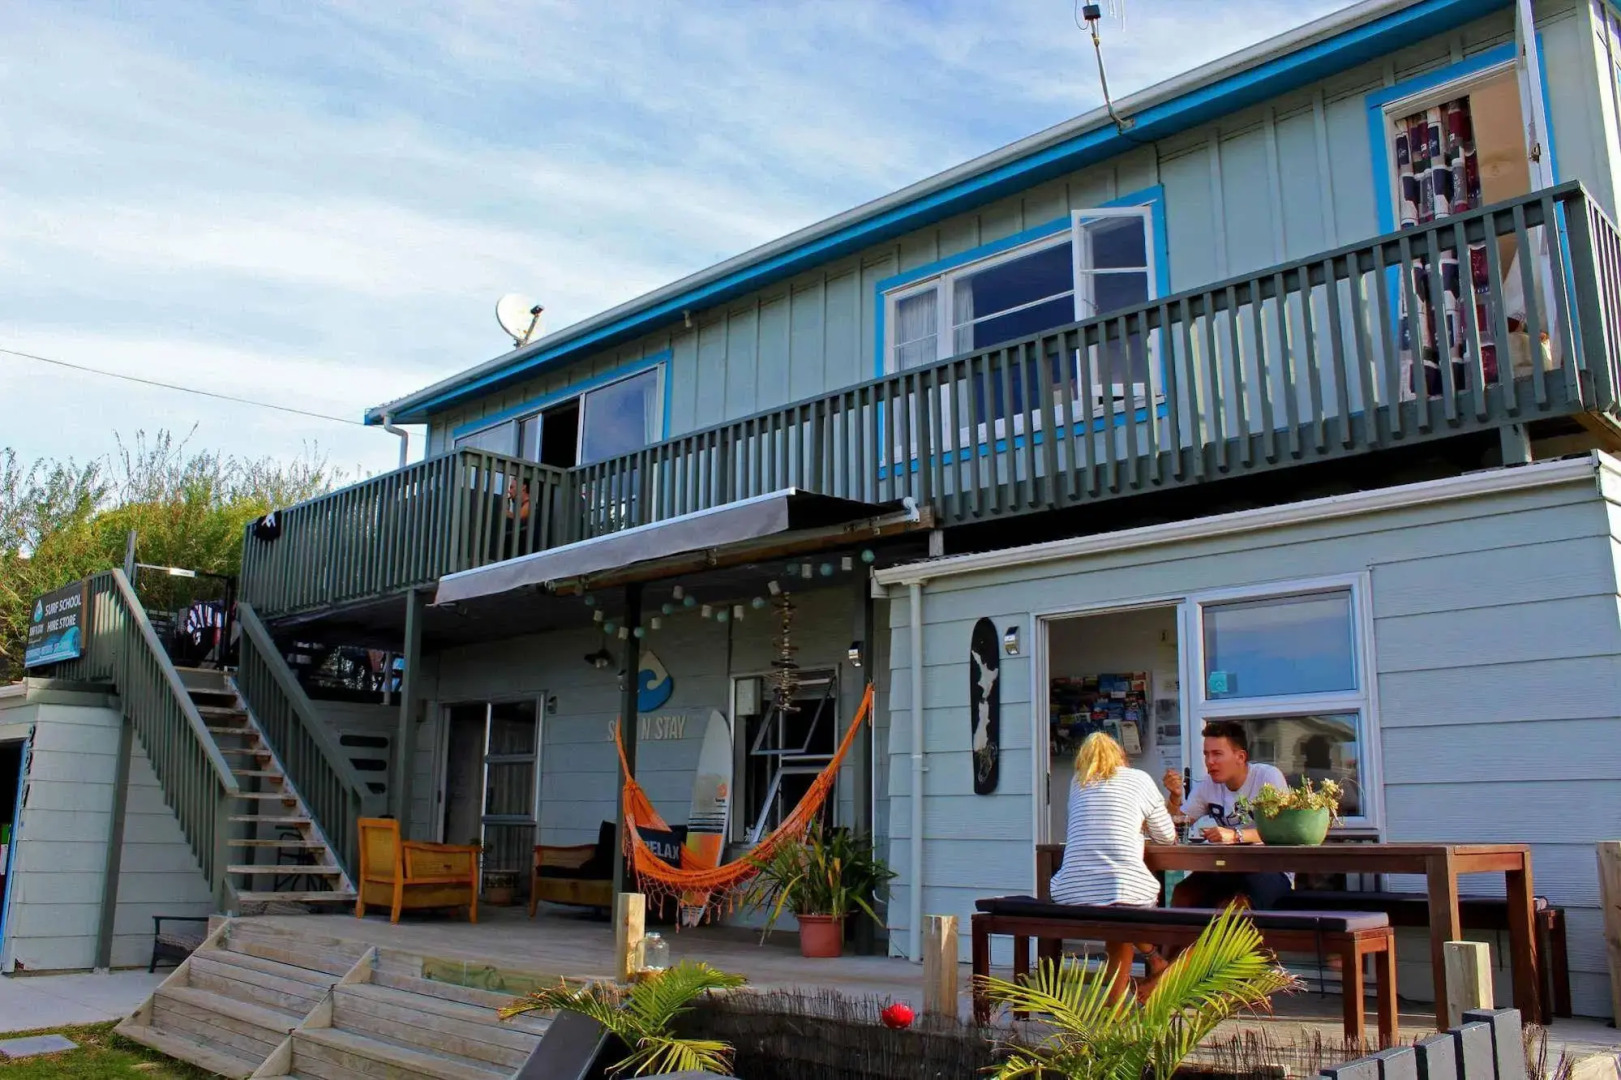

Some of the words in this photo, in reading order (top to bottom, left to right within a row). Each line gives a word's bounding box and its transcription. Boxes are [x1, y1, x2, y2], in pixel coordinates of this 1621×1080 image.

[44, 602, 58, 617] SURF
[59, 594, 82, 612] SCHOOL
[47, 618, 59, 633] HIRE
[59, 614, 76, 630] STORE
[655, 715, 686, 740] STAY
